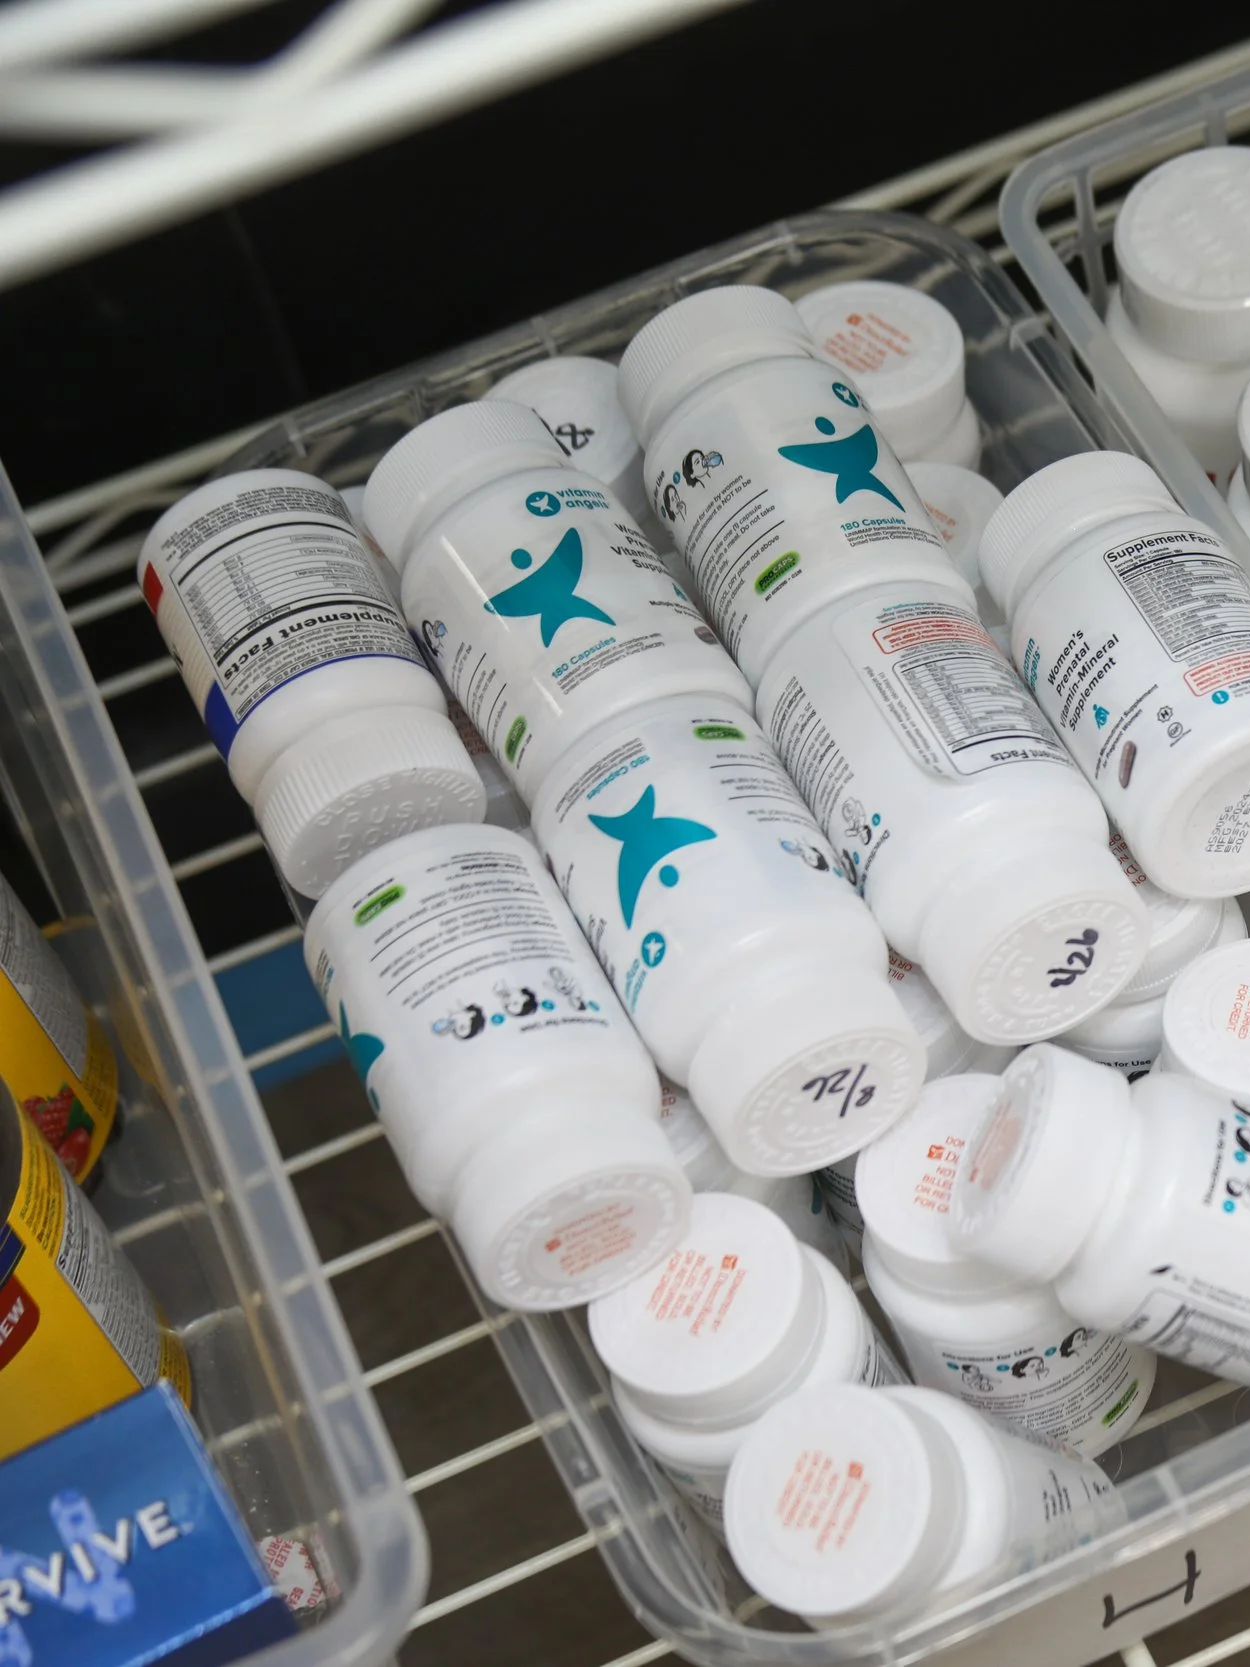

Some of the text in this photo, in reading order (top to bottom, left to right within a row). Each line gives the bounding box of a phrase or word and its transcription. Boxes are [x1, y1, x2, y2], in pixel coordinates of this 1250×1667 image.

[721, 475, 743, 494] women
[556, 489, 604, 501] vitamin
[722, 491, 734, 505] NOT
[739, 505, 761, 524] capsule
[750, 515, 760, 525] not
[760, 506, 775, 517] take
[841, 521, 859, 531] 180
[737, 560, 750, 576] place
[761, 536, 779, 552] above
[1107, 534, 1190, 562] Supplement
[1122, 569, 1143, 580] Amount
[224, 612, 403, 680] Supplement Facts
[570, 637, 616, 664] Capsules
[1048, 631, 1083, 685] Women's
[290, 665, 300, 675] CAP
[1056, 643, 1089, 694] Prenatal
[1069, 658, 1116, 729] Supplement
[1124, 684, 1158, 717] Supplement
[1122, 709, 1142, 731] Women
[991, 750, 1027, 764] Facts
[1236, 984, 1248, 1000] FOR
